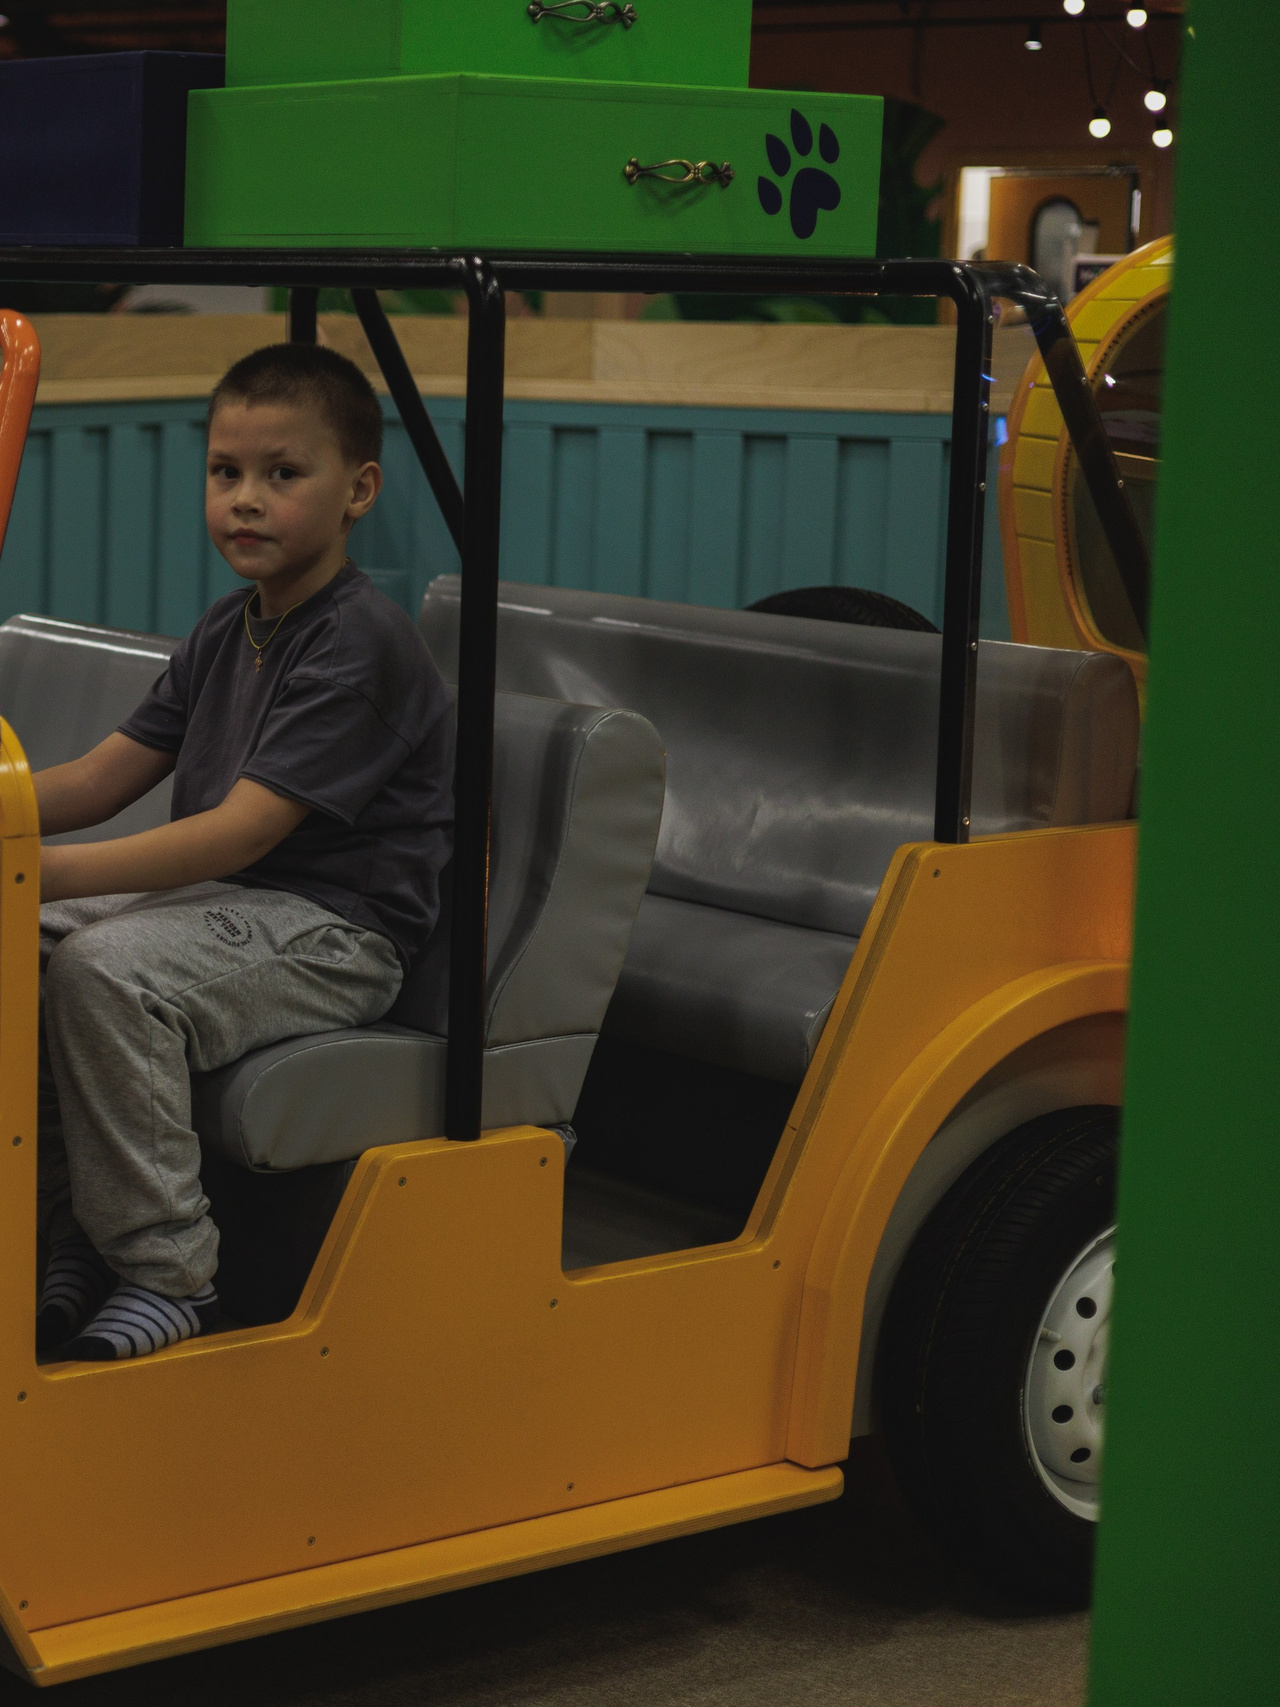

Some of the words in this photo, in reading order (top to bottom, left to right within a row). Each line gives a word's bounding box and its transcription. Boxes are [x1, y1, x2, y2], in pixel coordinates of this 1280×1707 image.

[206, 910, 222, 923] BEST
[220, 922, 237, 938] TEAM
[216, 911, 242, 936] PERFORM
[216, 932, 240, 948] FUTURE
